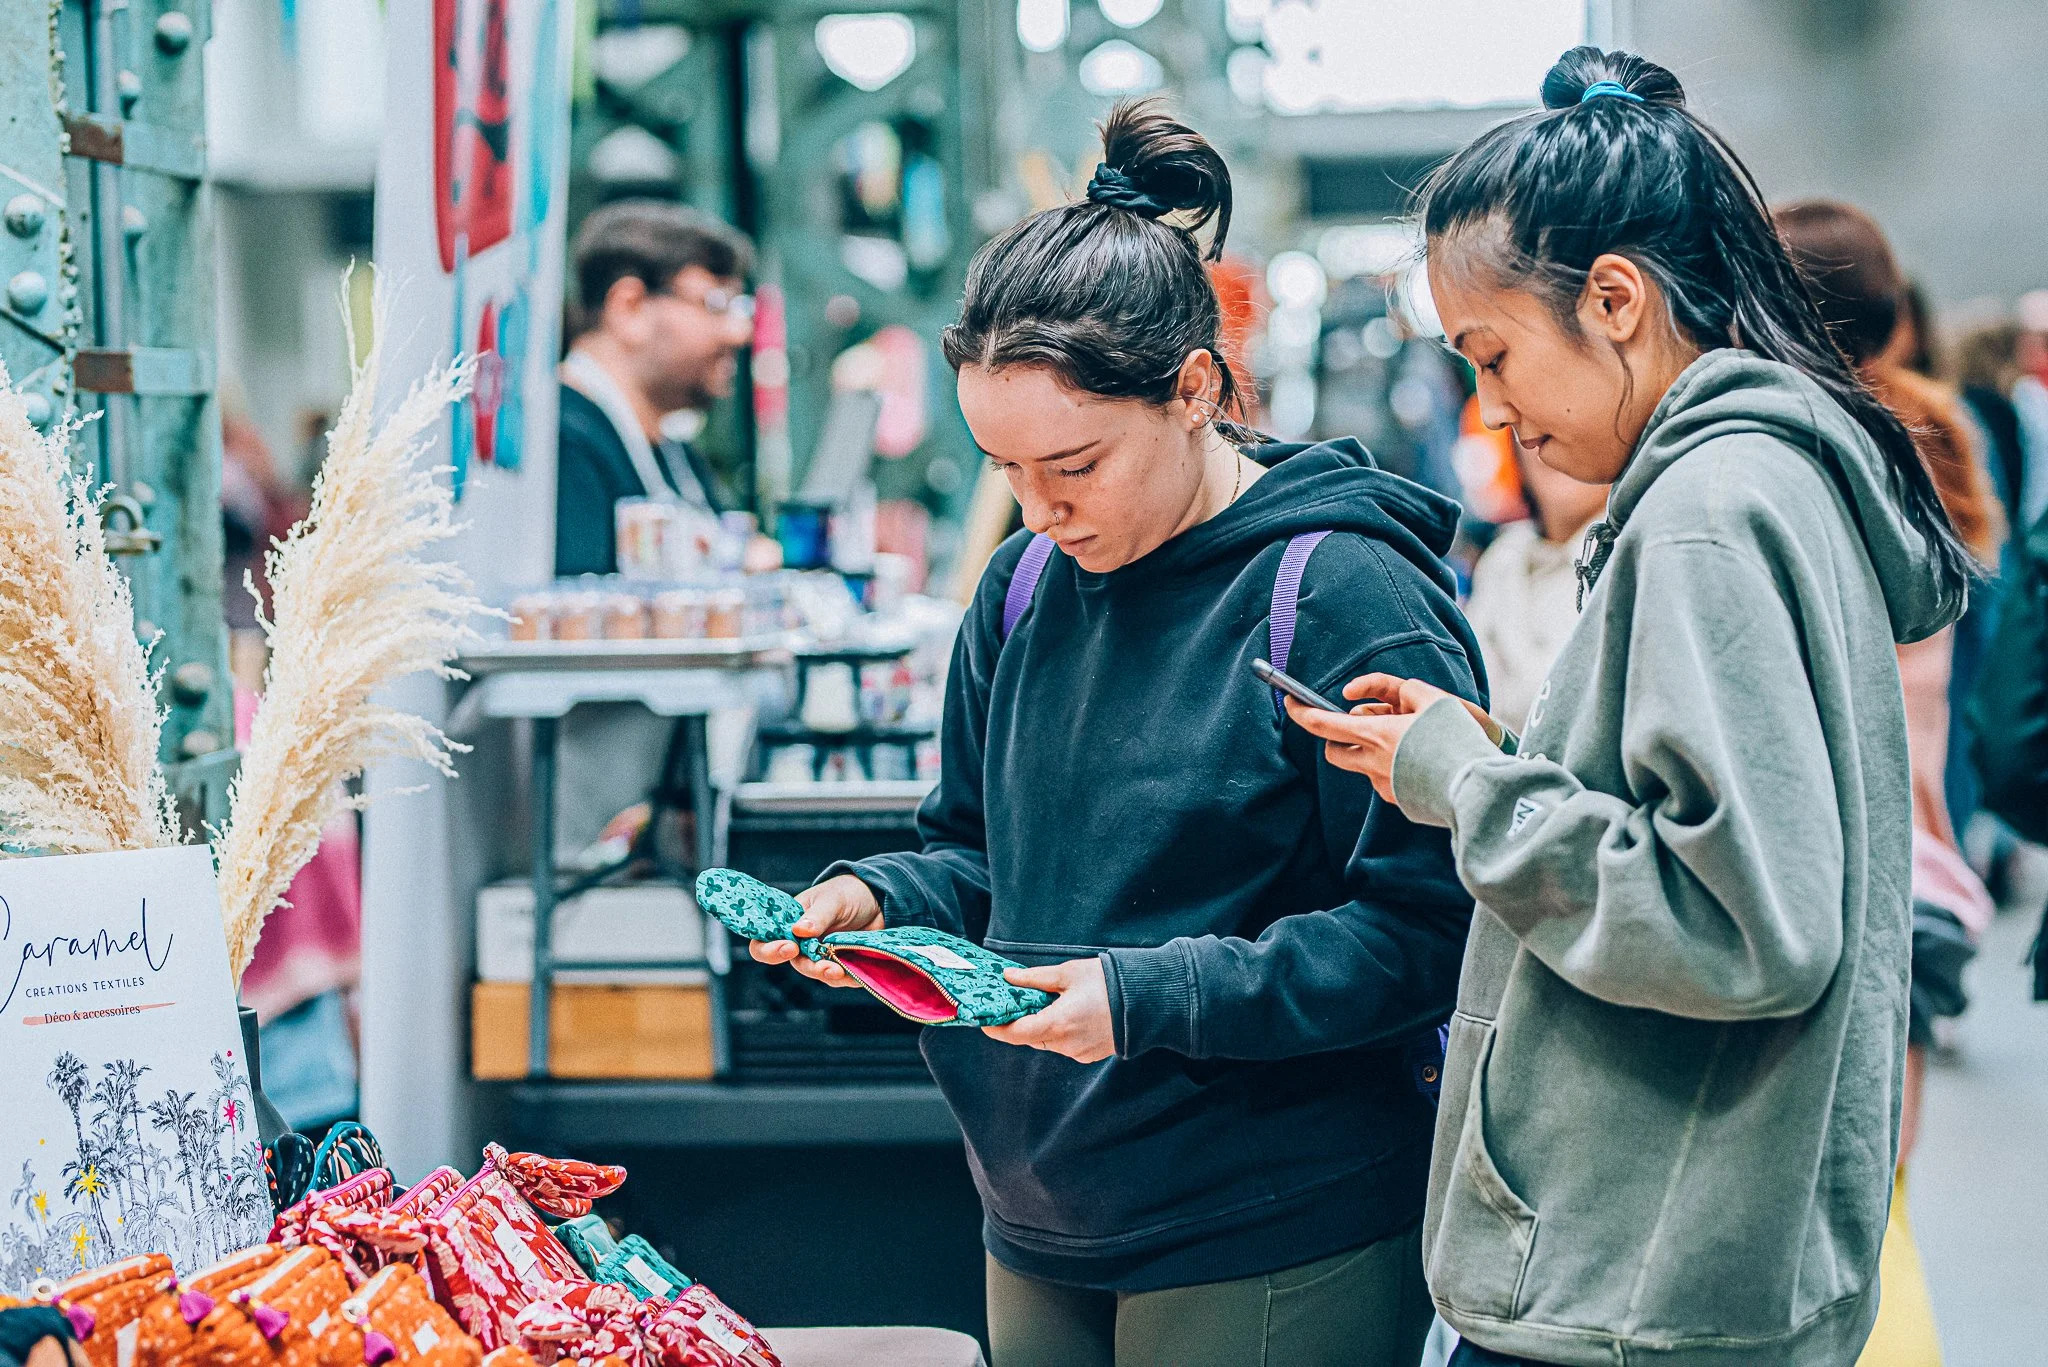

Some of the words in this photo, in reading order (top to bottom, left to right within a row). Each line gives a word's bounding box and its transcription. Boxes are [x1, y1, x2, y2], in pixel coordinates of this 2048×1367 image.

[25, 982, 88, 998] CREATIONS
[93, 976, 145, 991] TEXTILES
[44, 1011, 71, 1024] Déco
[73, 1010, 81, 1020] &
[82, 1004, 141, 1020] accessoires
